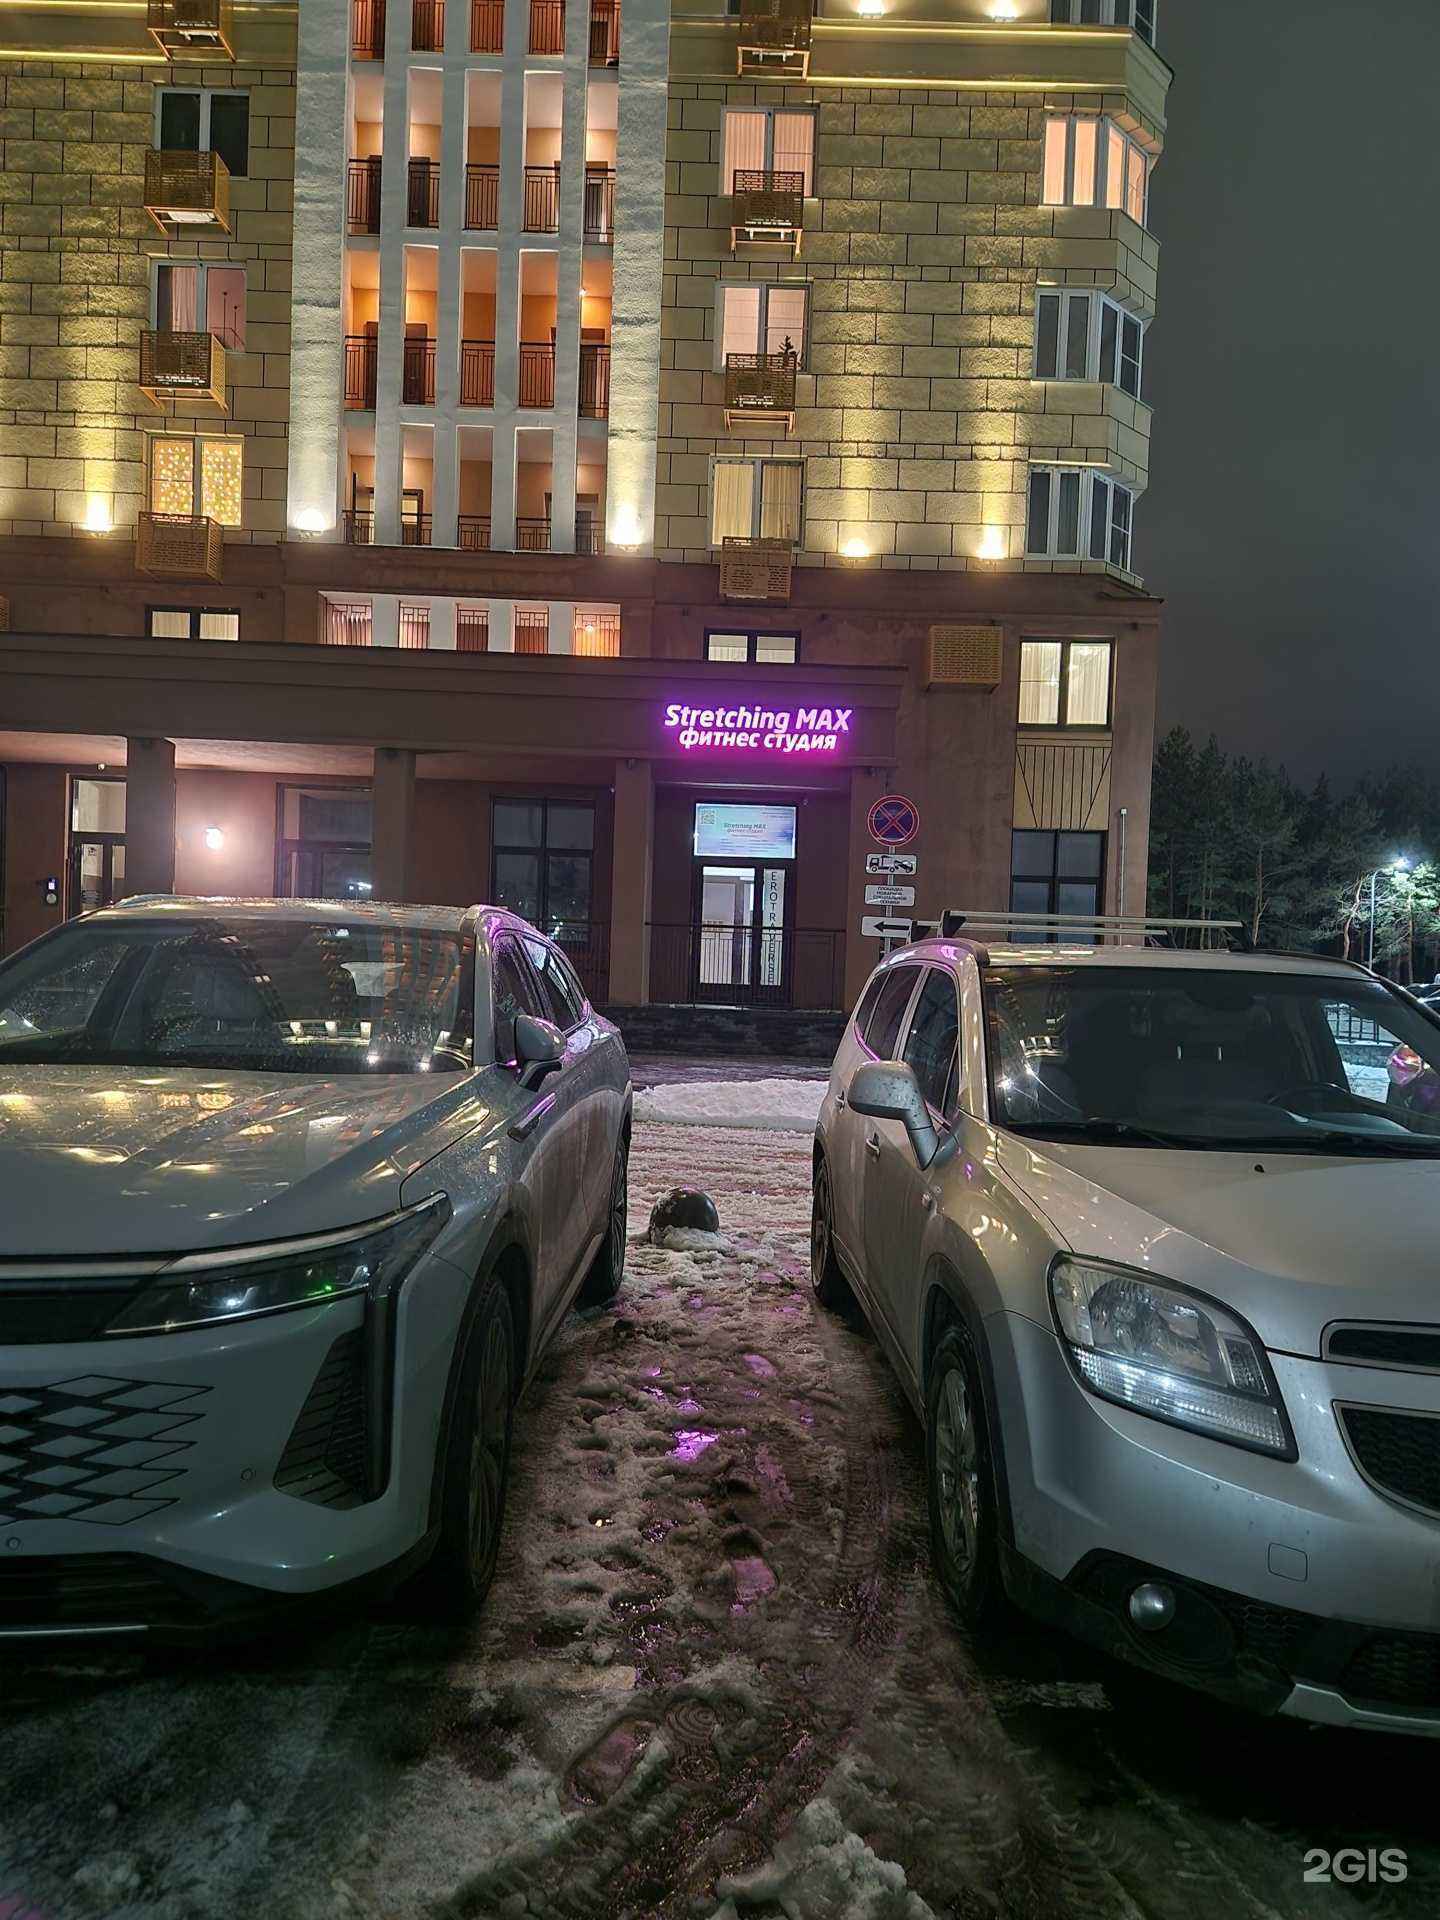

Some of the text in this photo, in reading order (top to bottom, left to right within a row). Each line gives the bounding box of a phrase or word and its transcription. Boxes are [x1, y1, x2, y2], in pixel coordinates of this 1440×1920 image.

[664, 704, 852, 734] Stretching MAX
[679, 727, 837, 752] фитнес студия
